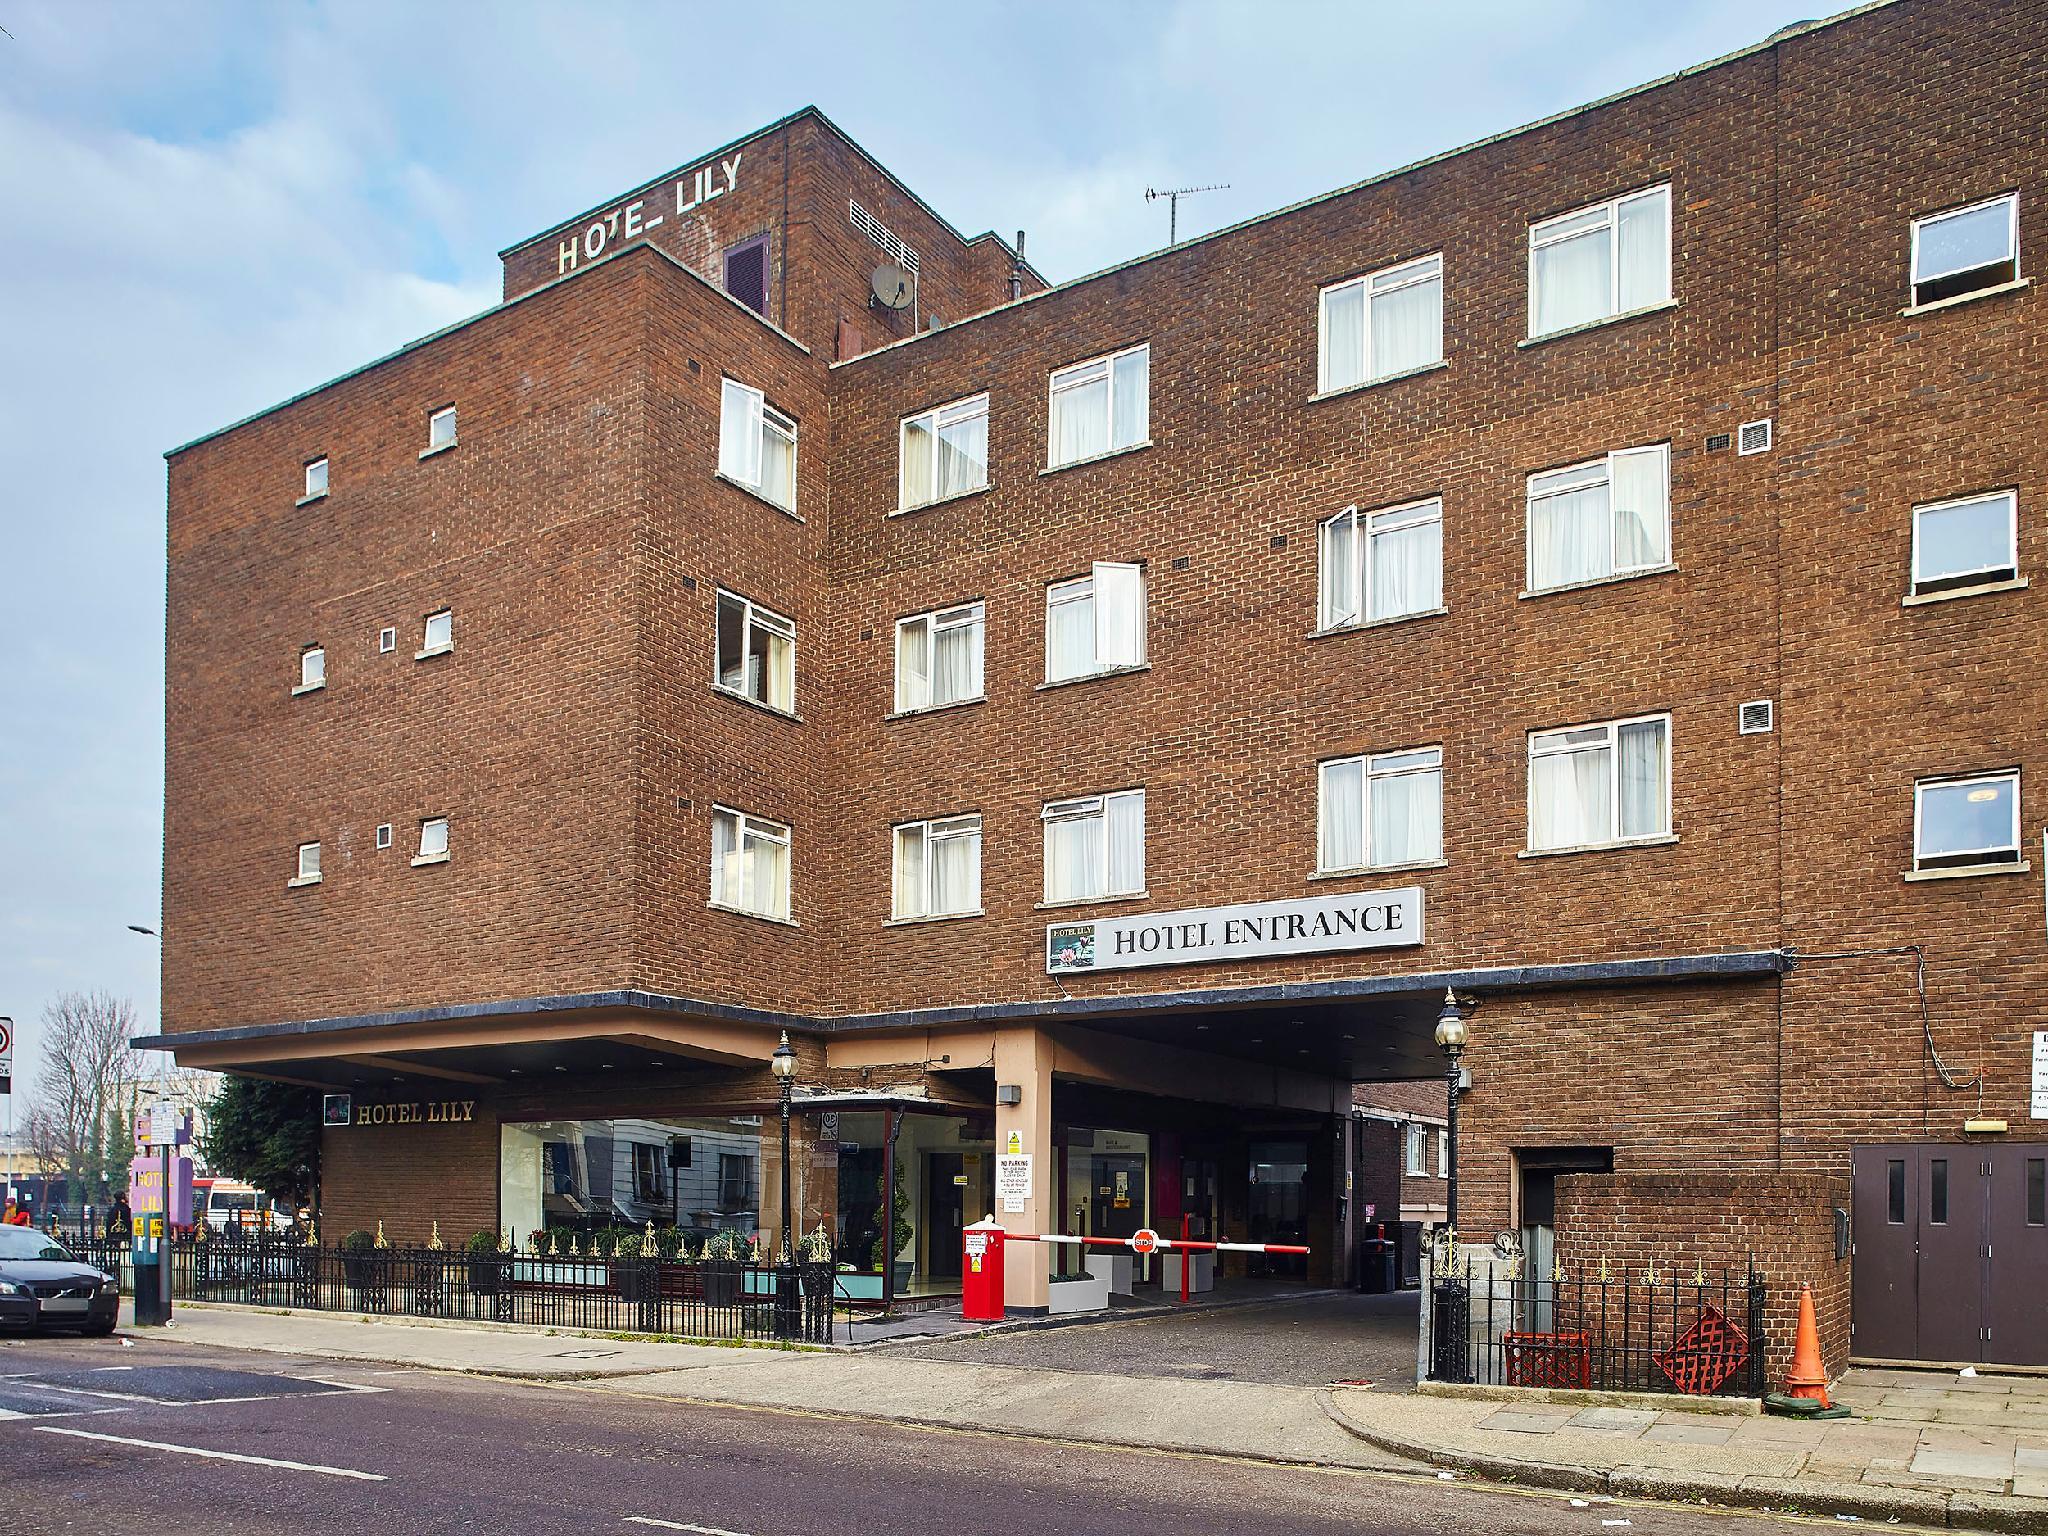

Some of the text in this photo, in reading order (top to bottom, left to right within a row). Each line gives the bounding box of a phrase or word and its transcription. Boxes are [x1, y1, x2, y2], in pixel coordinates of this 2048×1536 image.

[558, 152, 742, 275] HOTE LILY
[1053, 929, 1077, 938] HOTEL
[1114, 903, 1404, 955] HOTEL ENTRANCE
[356, 1100, 475, 1125] HOTEL LILY
[1135, 1238, 1153, 1247] STOP
